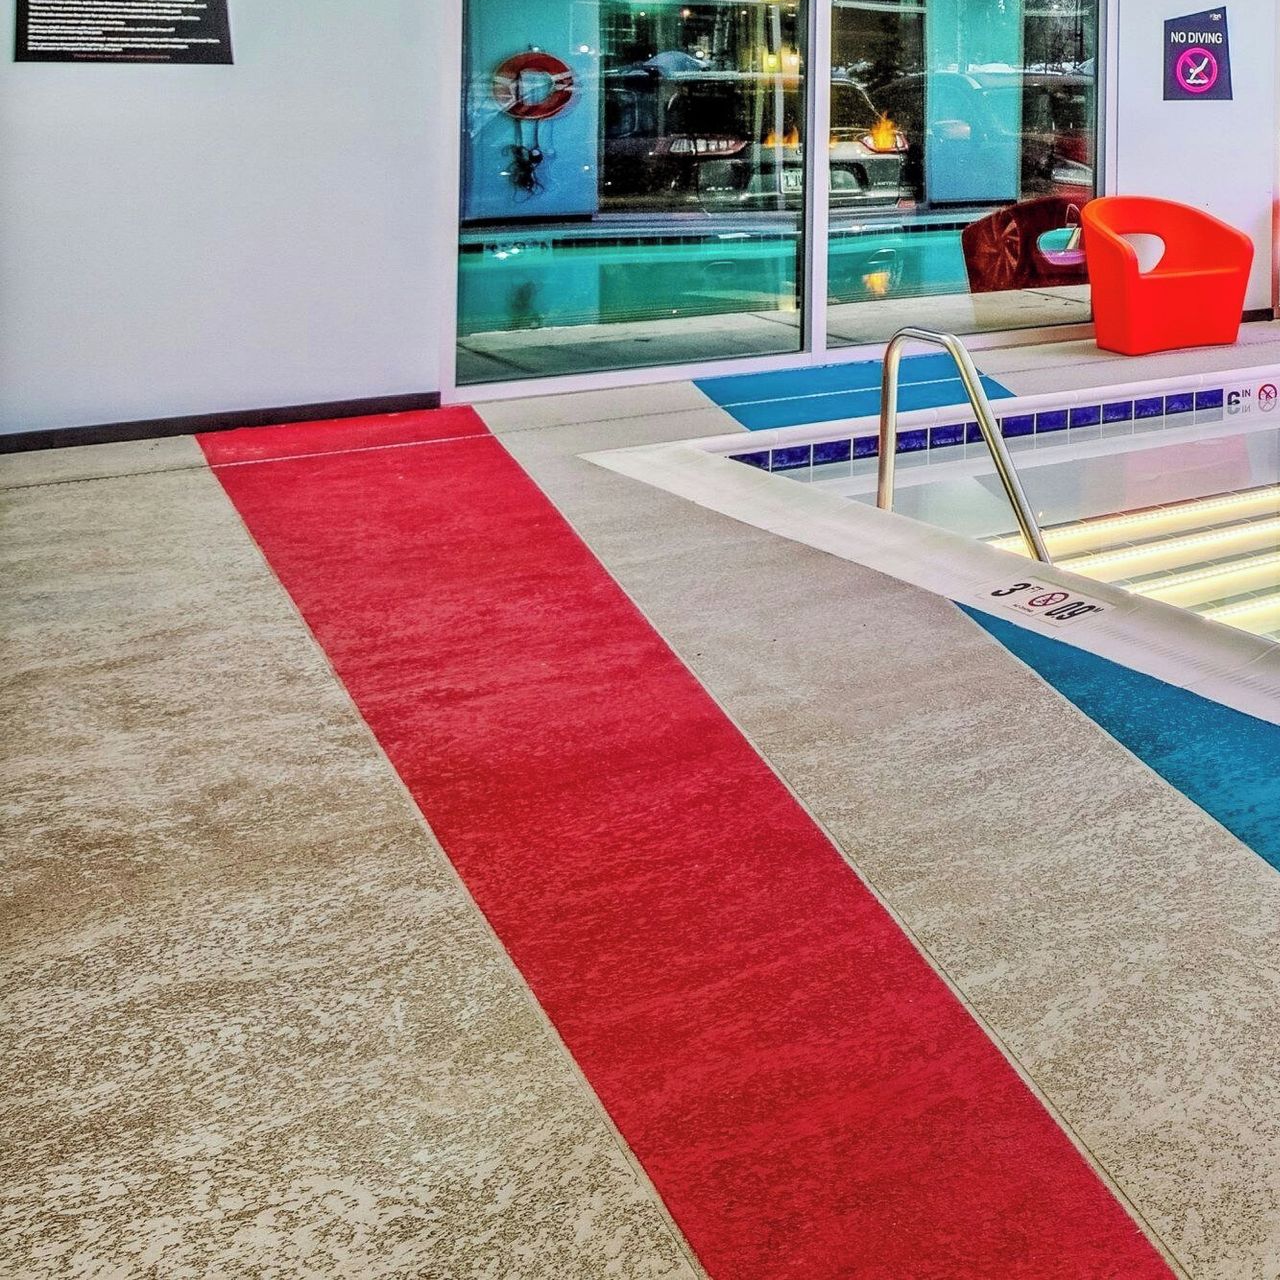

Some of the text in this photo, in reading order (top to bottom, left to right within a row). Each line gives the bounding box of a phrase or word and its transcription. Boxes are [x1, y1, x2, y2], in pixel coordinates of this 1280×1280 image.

[1170, 32, 1223, 44] NO DIVING
[1241, 388, 1251, 398] IN
[991, 583, 1032, 597] 3
